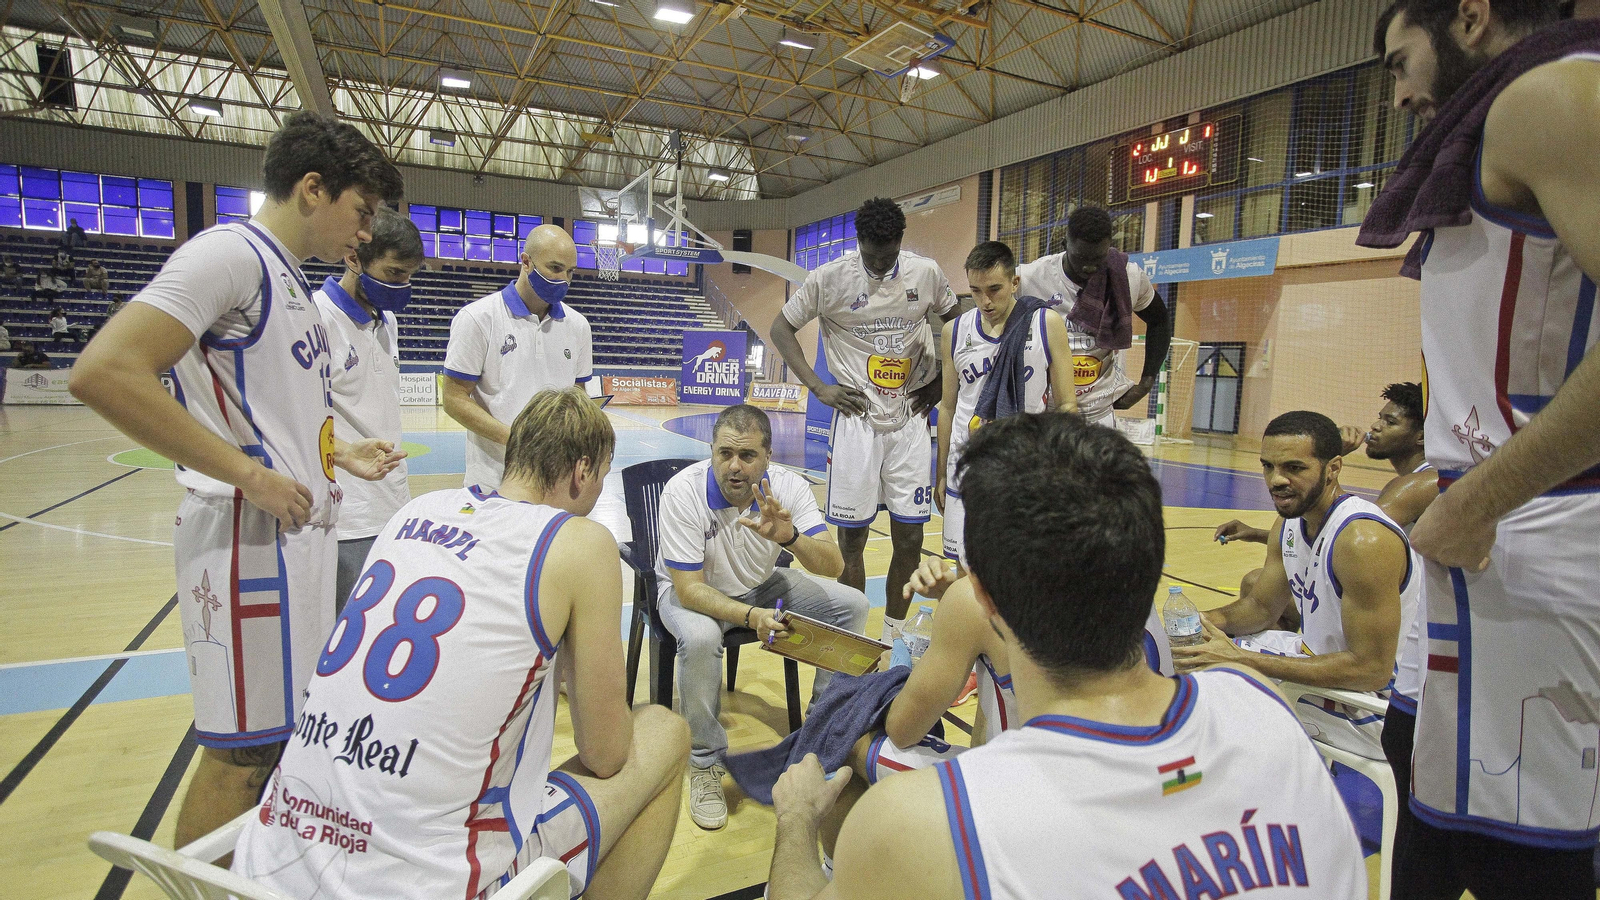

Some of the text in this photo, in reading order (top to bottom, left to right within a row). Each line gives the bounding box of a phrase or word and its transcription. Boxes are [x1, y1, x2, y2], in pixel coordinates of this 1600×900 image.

[655, 247, 700, 258] SPORT SYSTEM
[873, 332, 905, 354] 85
[705, 361, 739, 374] ENER
[400, 375, 432, 383] Hospital
[696, 372, 739, 385] DRINK
[873, 369, 906, 380] Reina
[400, 384, 432, 394] salud
[612, 378, 667, 388] Socialistas
[683, 385, 741, 397] ENERGY DRINK
[753, 387, 799, 399] SAAVEDRA
[914, 485, 932, 505] 85
[394, 517, 481, 561] HAMPL
[316, 559, 465, 702] 88
[333, 713, 419, 778] Real
[319, 824, 368, 853] Rioja
[1115, 809, 1309, 900] MARÍN
